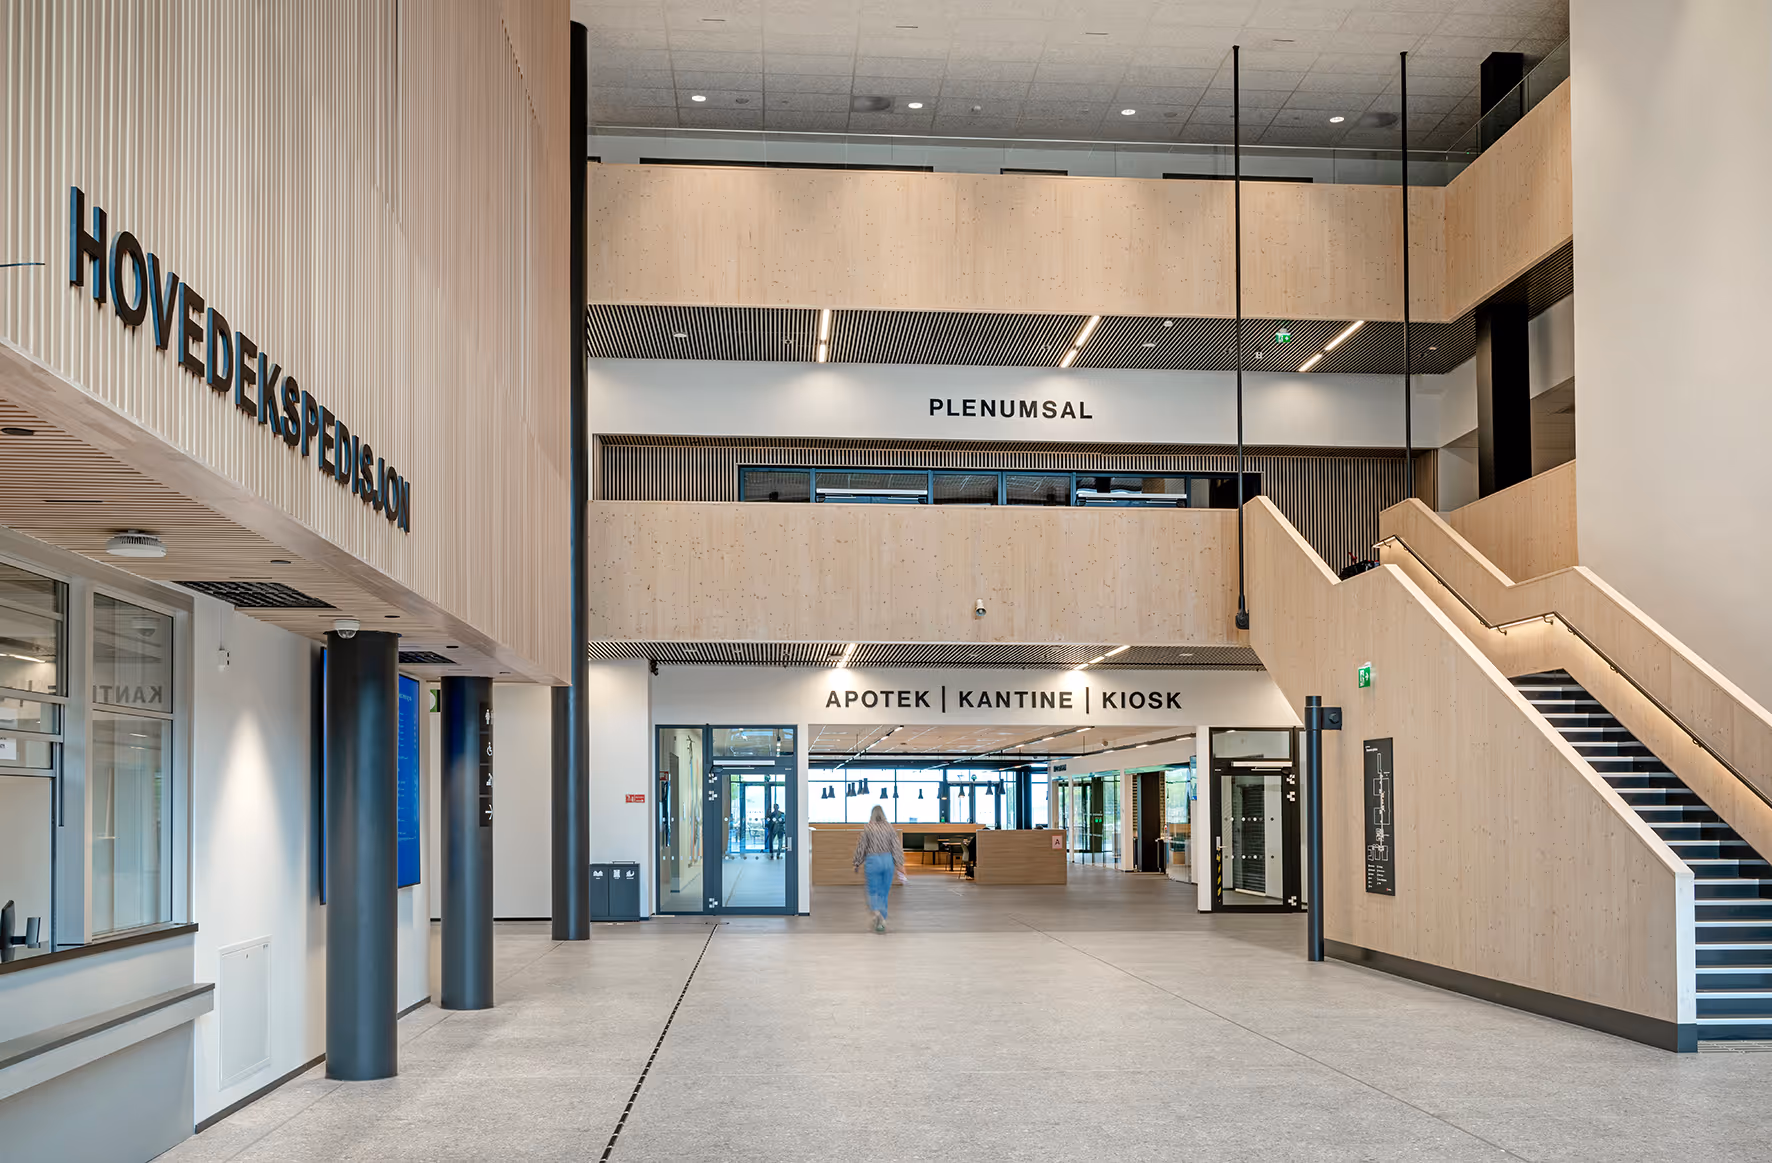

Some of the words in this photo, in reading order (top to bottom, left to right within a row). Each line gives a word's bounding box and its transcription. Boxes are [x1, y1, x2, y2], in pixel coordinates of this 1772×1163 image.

[69, 185, 411, 534] HOVEDEKSPEDISJON
[929, 398, 1093, 419] PLENUMSAL
[825, 690, 931, 708] APOTEK
[959, 690, 1073, 709] KANTINE
[1102, 691, 1182, 710] KIOSK
